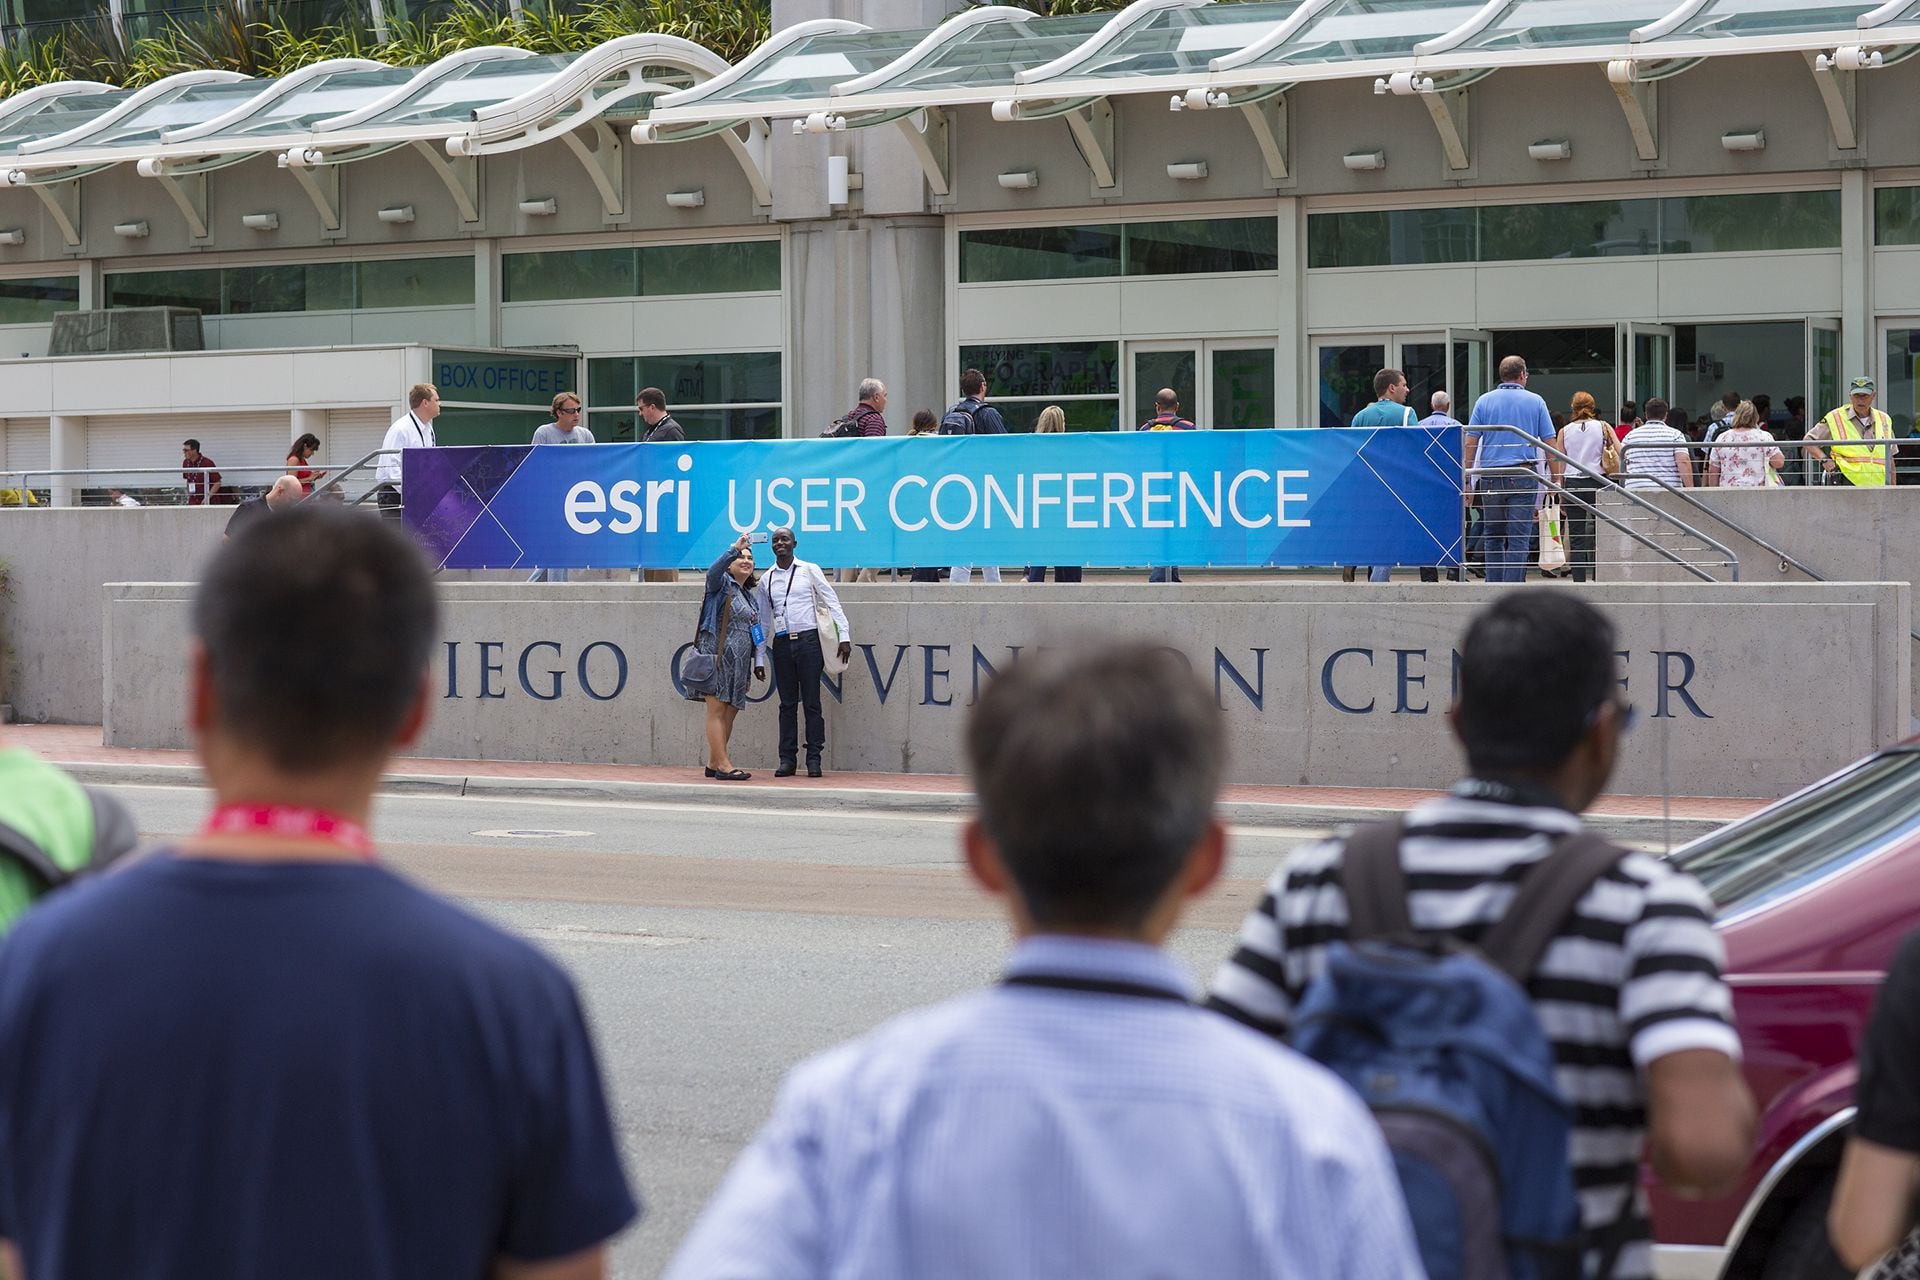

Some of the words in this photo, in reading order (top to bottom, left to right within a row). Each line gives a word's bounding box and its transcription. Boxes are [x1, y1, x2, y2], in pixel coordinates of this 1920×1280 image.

[966, 349, 1025, 361] APPLYING
[441, 364, 478, 388] BOX
[484, 366, 548, 392] OFFICE
[677, 377, 700, 399] ATM
[1011, 382, 1117, 395] EVERYWHERE
[564, 453, 692, 535] esri
[728, 477, 866, 533] USER
[888, 469, 1311, 532] CONFERENCE
[443, 640, 629, 701] IEGO
[1321, 647, 1714, 719] CER
